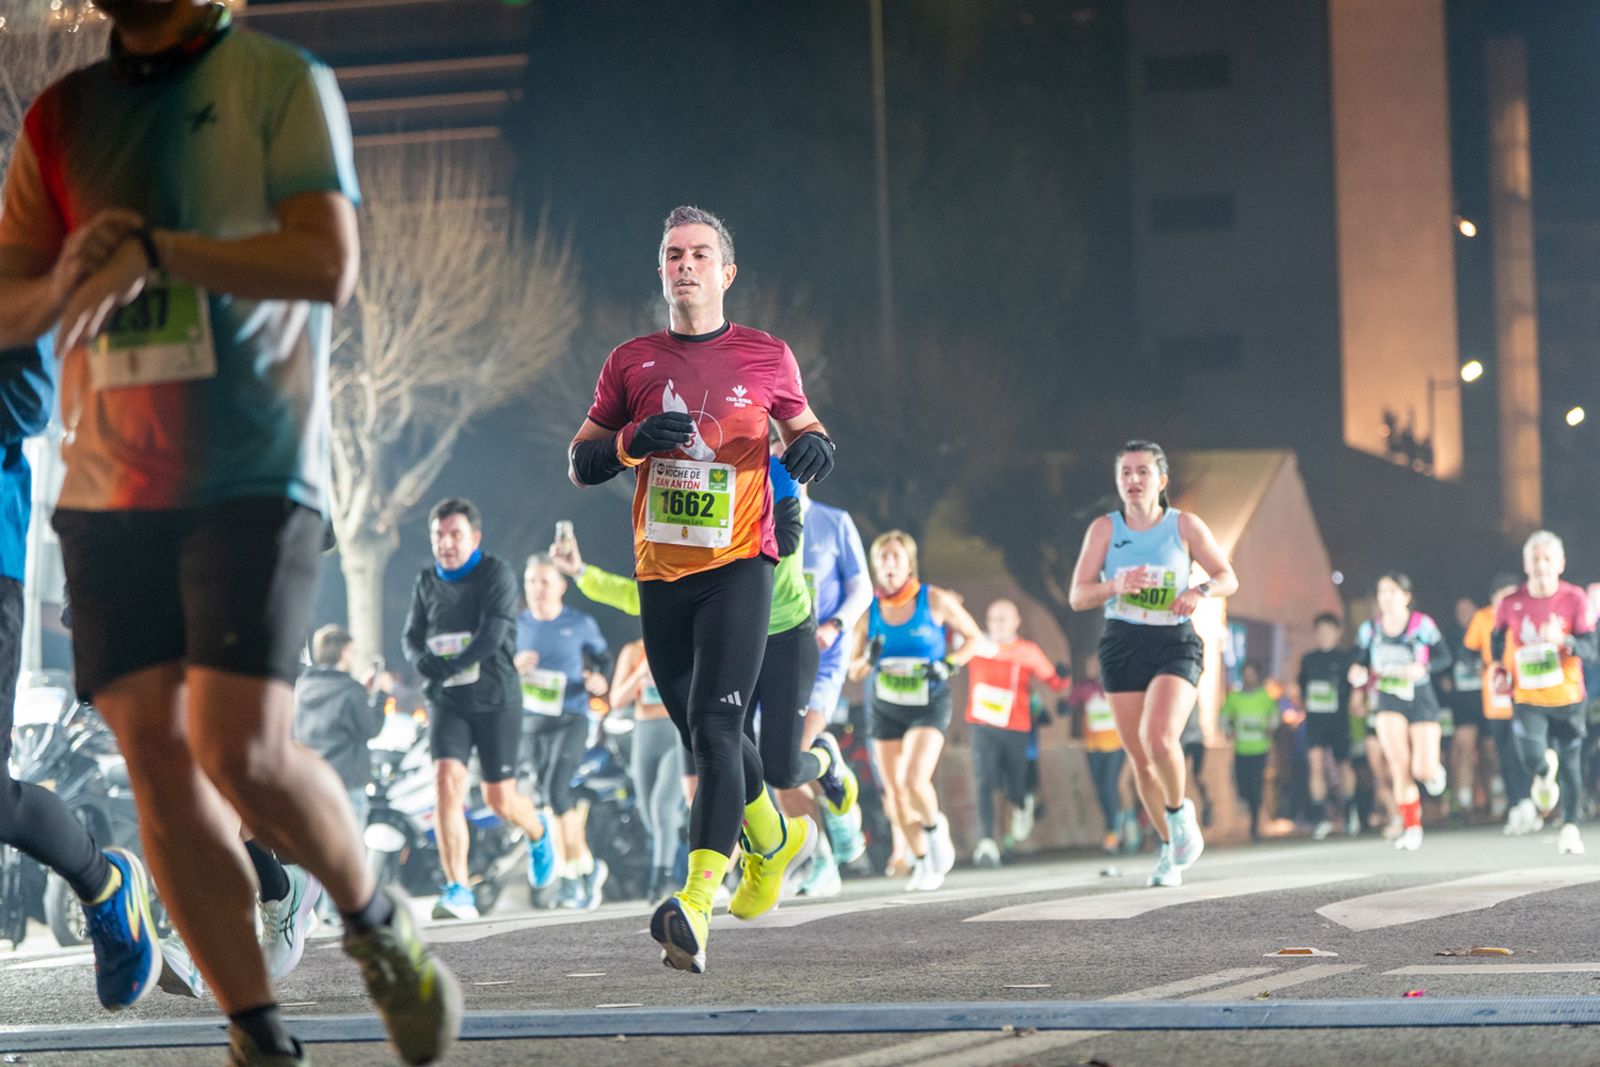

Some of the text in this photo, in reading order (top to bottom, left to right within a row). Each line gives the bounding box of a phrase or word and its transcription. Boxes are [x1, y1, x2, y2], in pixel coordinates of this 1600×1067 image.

[664, 468, 689, 480] NOCHE
[690, 470, 701, 480] DE
[656, 478, 671, 488] SAN
[661, 490, 715, 518] 1662
